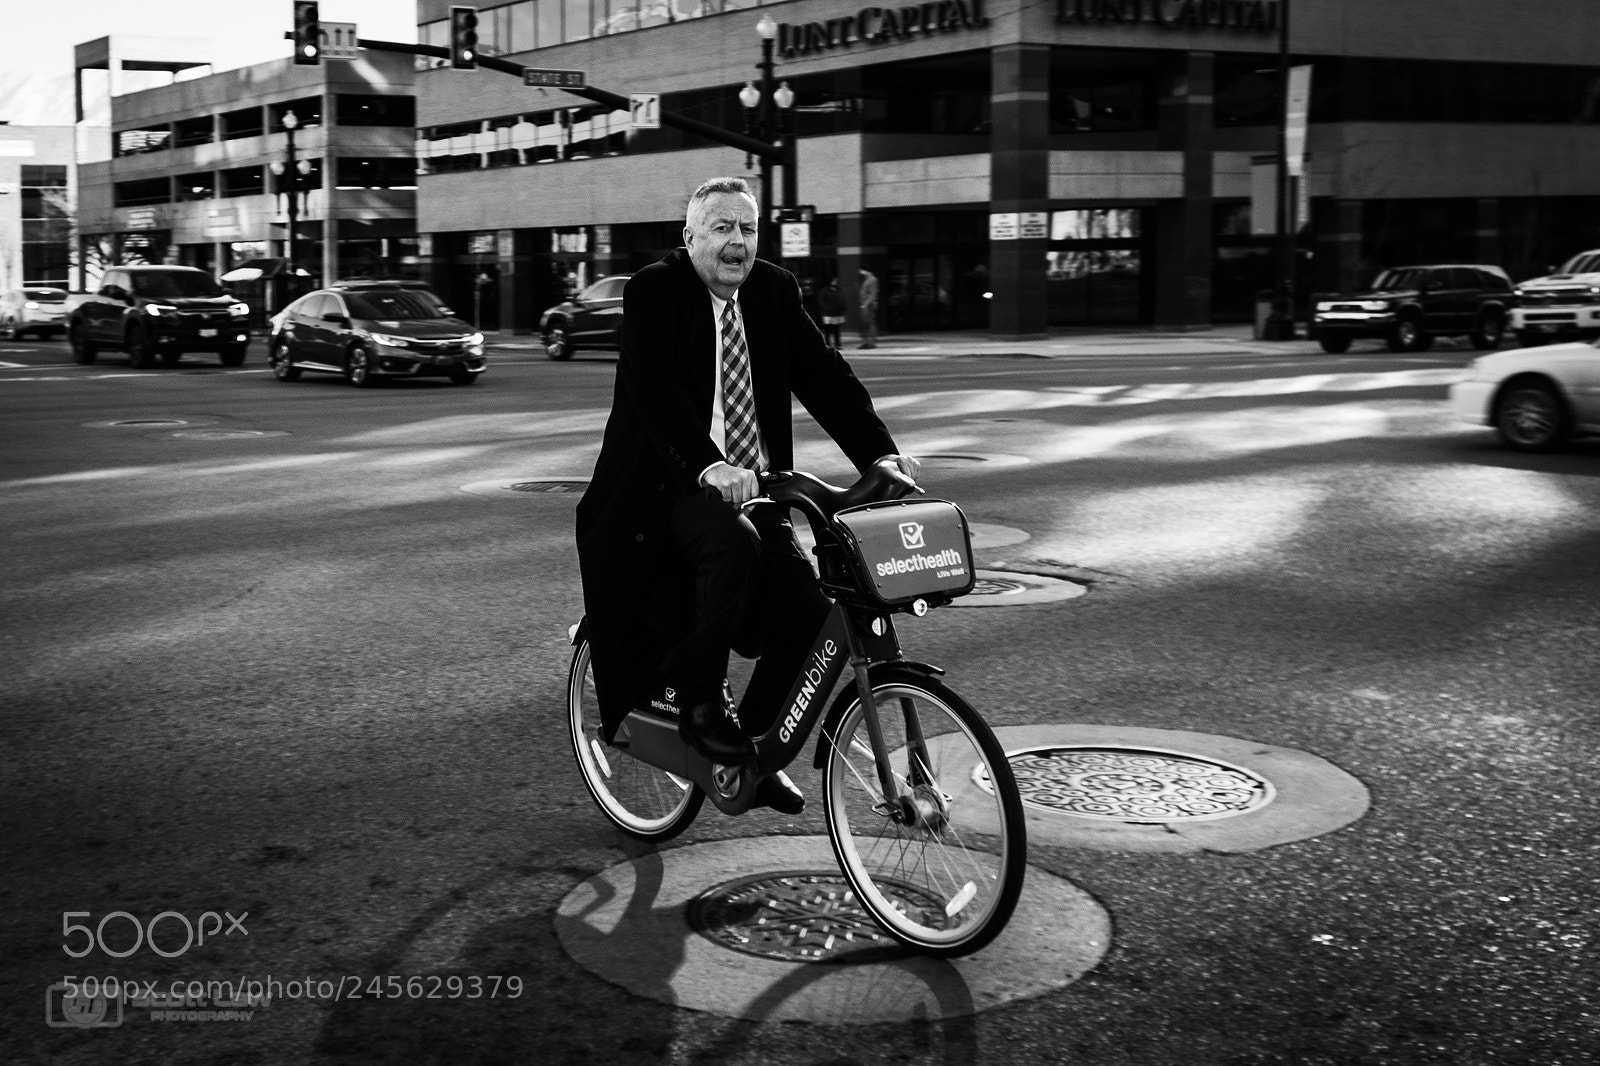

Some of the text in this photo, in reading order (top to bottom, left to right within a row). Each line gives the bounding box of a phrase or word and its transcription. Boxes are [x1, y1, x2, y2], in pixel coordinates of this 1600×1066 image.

[776, 0, 991, 57] LUNT CAPITAL
[876, 548, 962, 577] selecthealth
[651, 700, 680, 715] selecthea
[779, 639, 837, 743] GREENbike
